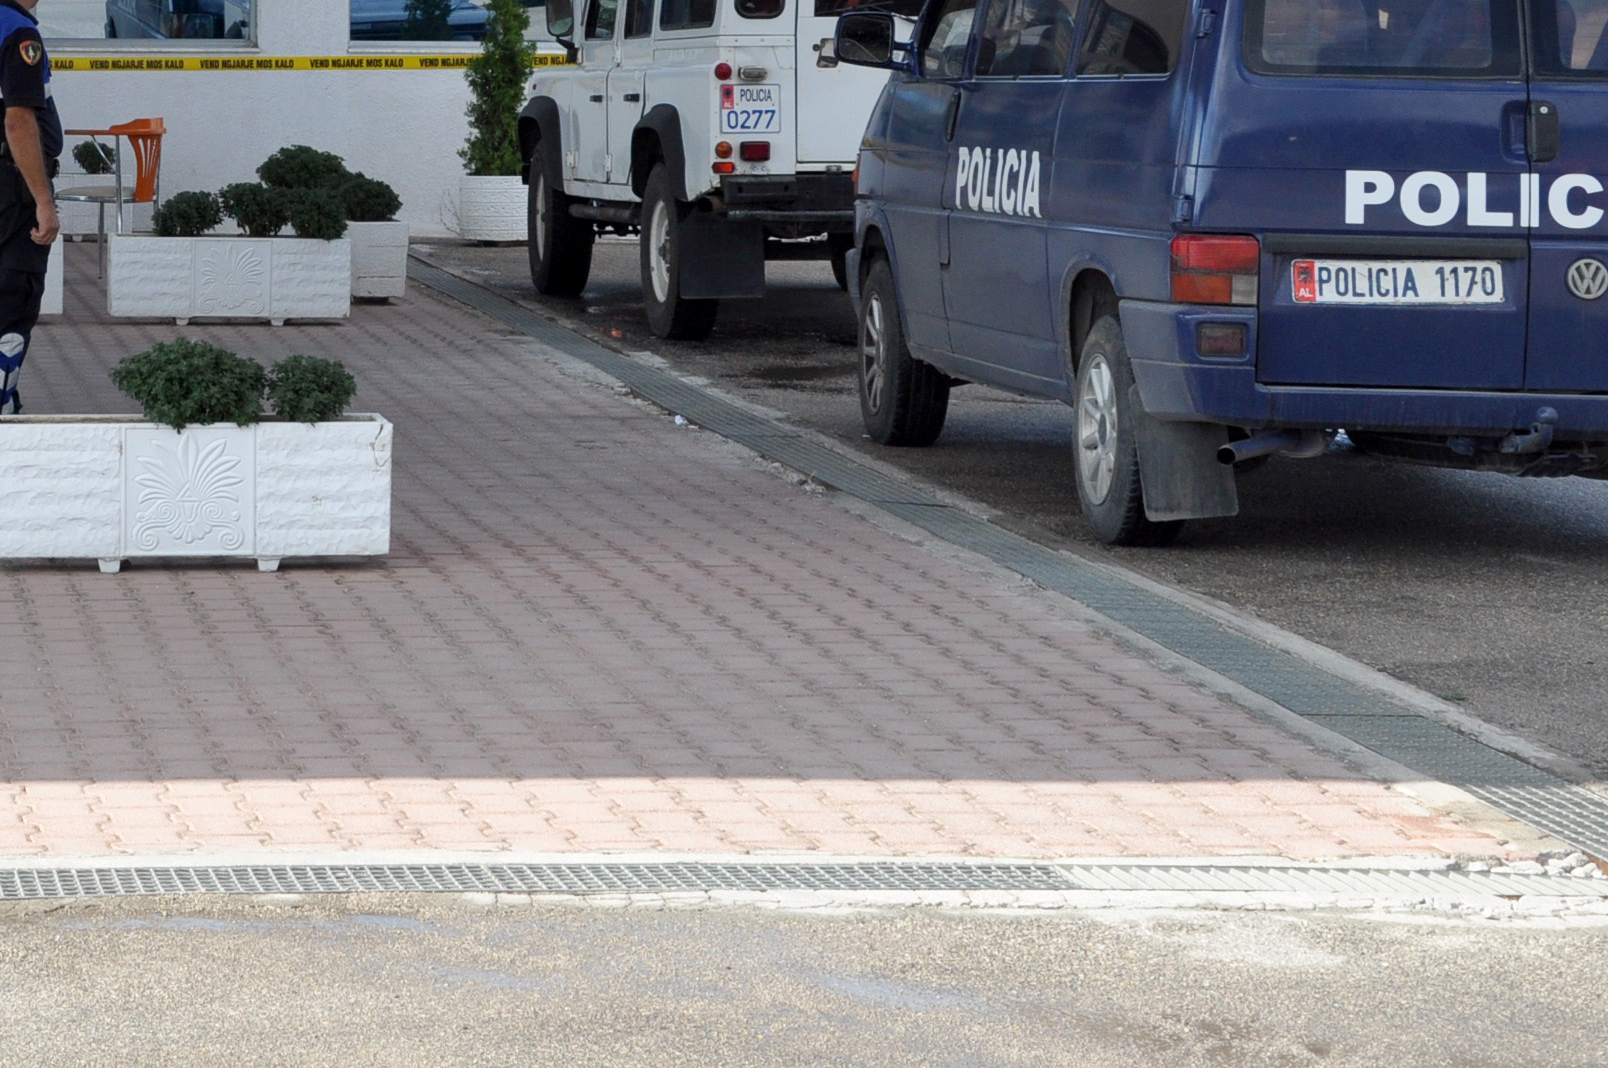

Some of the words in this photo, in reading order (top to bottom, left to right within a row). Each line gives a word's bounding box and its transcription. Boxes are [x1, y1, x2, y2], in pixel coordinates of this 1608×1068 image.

[54, 59, 74, 69] KALO
[90, 59, 110, 69] VEND
[111, 59, 144, 69] NGJARJE
[146, 59, 163, 69] MOS
[164, 59, 184, 69] KALO
[200, 59, 220, 69] VEND
[221, 59, 254, 69] NGJARJE
[256, 59, 273, 69] MOS
[274, 59, 294, 69] KALO
[309, 58, 330, 68] VEND
[331, 58, 364, 68] NGJARJE
[365, 58, 383, 68] MOS
[384, 58, 404, 68] KALO
[419, 58, 439, 67] VEND
[532, 56, 548, 66] END
[740, 88, 772, 102] POLICIA
[727, 109, 776, 129] 0277
[955, 146, 1042, 218] POLICIA
[1345, 170, 1605, 228] POLIC
[1318, 266, 1419, 298] POLICIA
[1435, 266, 1497, 298] 1170
[1298, 288, 1313, 298] AL
